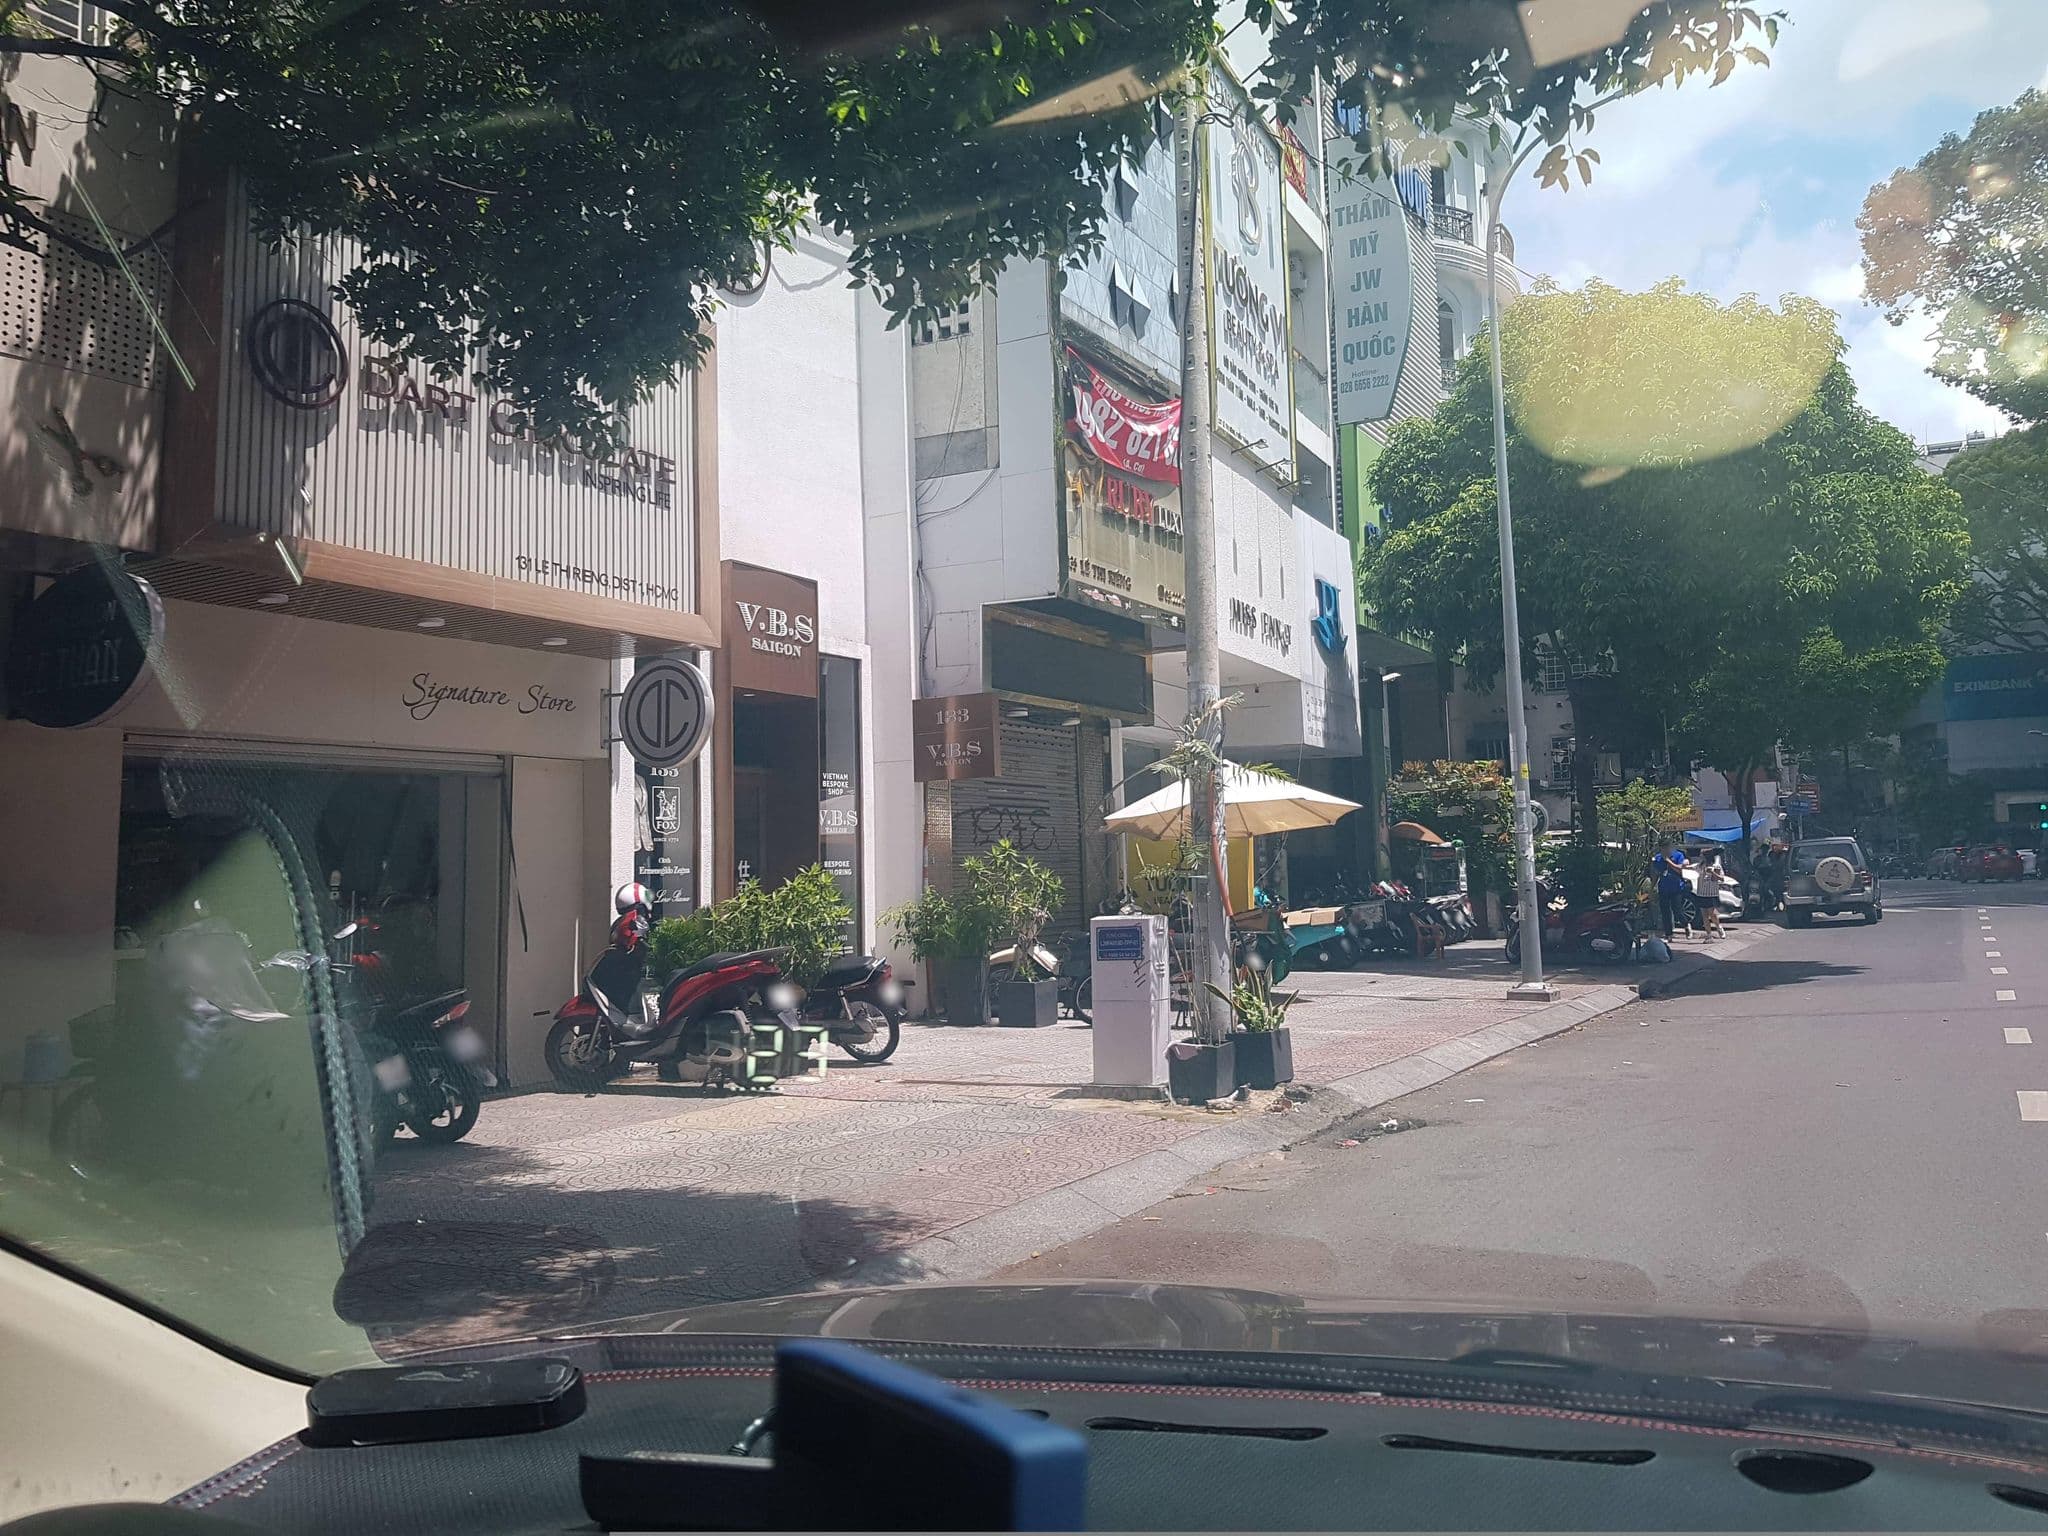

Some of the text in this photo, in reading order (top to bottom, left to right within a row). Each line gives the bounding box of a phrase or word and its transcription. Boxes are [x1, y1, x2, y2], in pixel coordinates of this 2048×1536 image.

[1335, 193, 1391, 227] THẨM
[1349, 230, 1380, 259] MỸ
[1350, 267, 1382, 293] JW
[1346, 301, 1389, 329] HÀN
[1342, 331, 1396, 366] QUỐC
[363, 354, 477, 423] DART
[1372, 374, 1390, 388] 2222
[648, 488, 671, 510] LIFE
[515, 554, 532, 572] 131
[534, 558, 550, 575] LE
[552, 562, 571, 579] THI
[612, 575, 637, 594] DIST
[646, 583, 679, 601] HCMC
[736, 601, 814, 643] V.B.S
[1229, 597, 1257, 629] MISS
[751, 637, 802, 657] SAIGON
[1953, 679, 2033, 692] EXIMBANK
[402, 673, 577, 721] Signature Store
[935, 708, 970, 725] 133
[926, 740, 982, 760] V.B.S
[935, 758, 972, 767] SAIGON
[822, 773, 849, 781] VIETNAM
[827, 788, 844, 796] SHOP
[656, 820, 676, 830] FOX
[823, 860, 850, 868] BESPOKE
